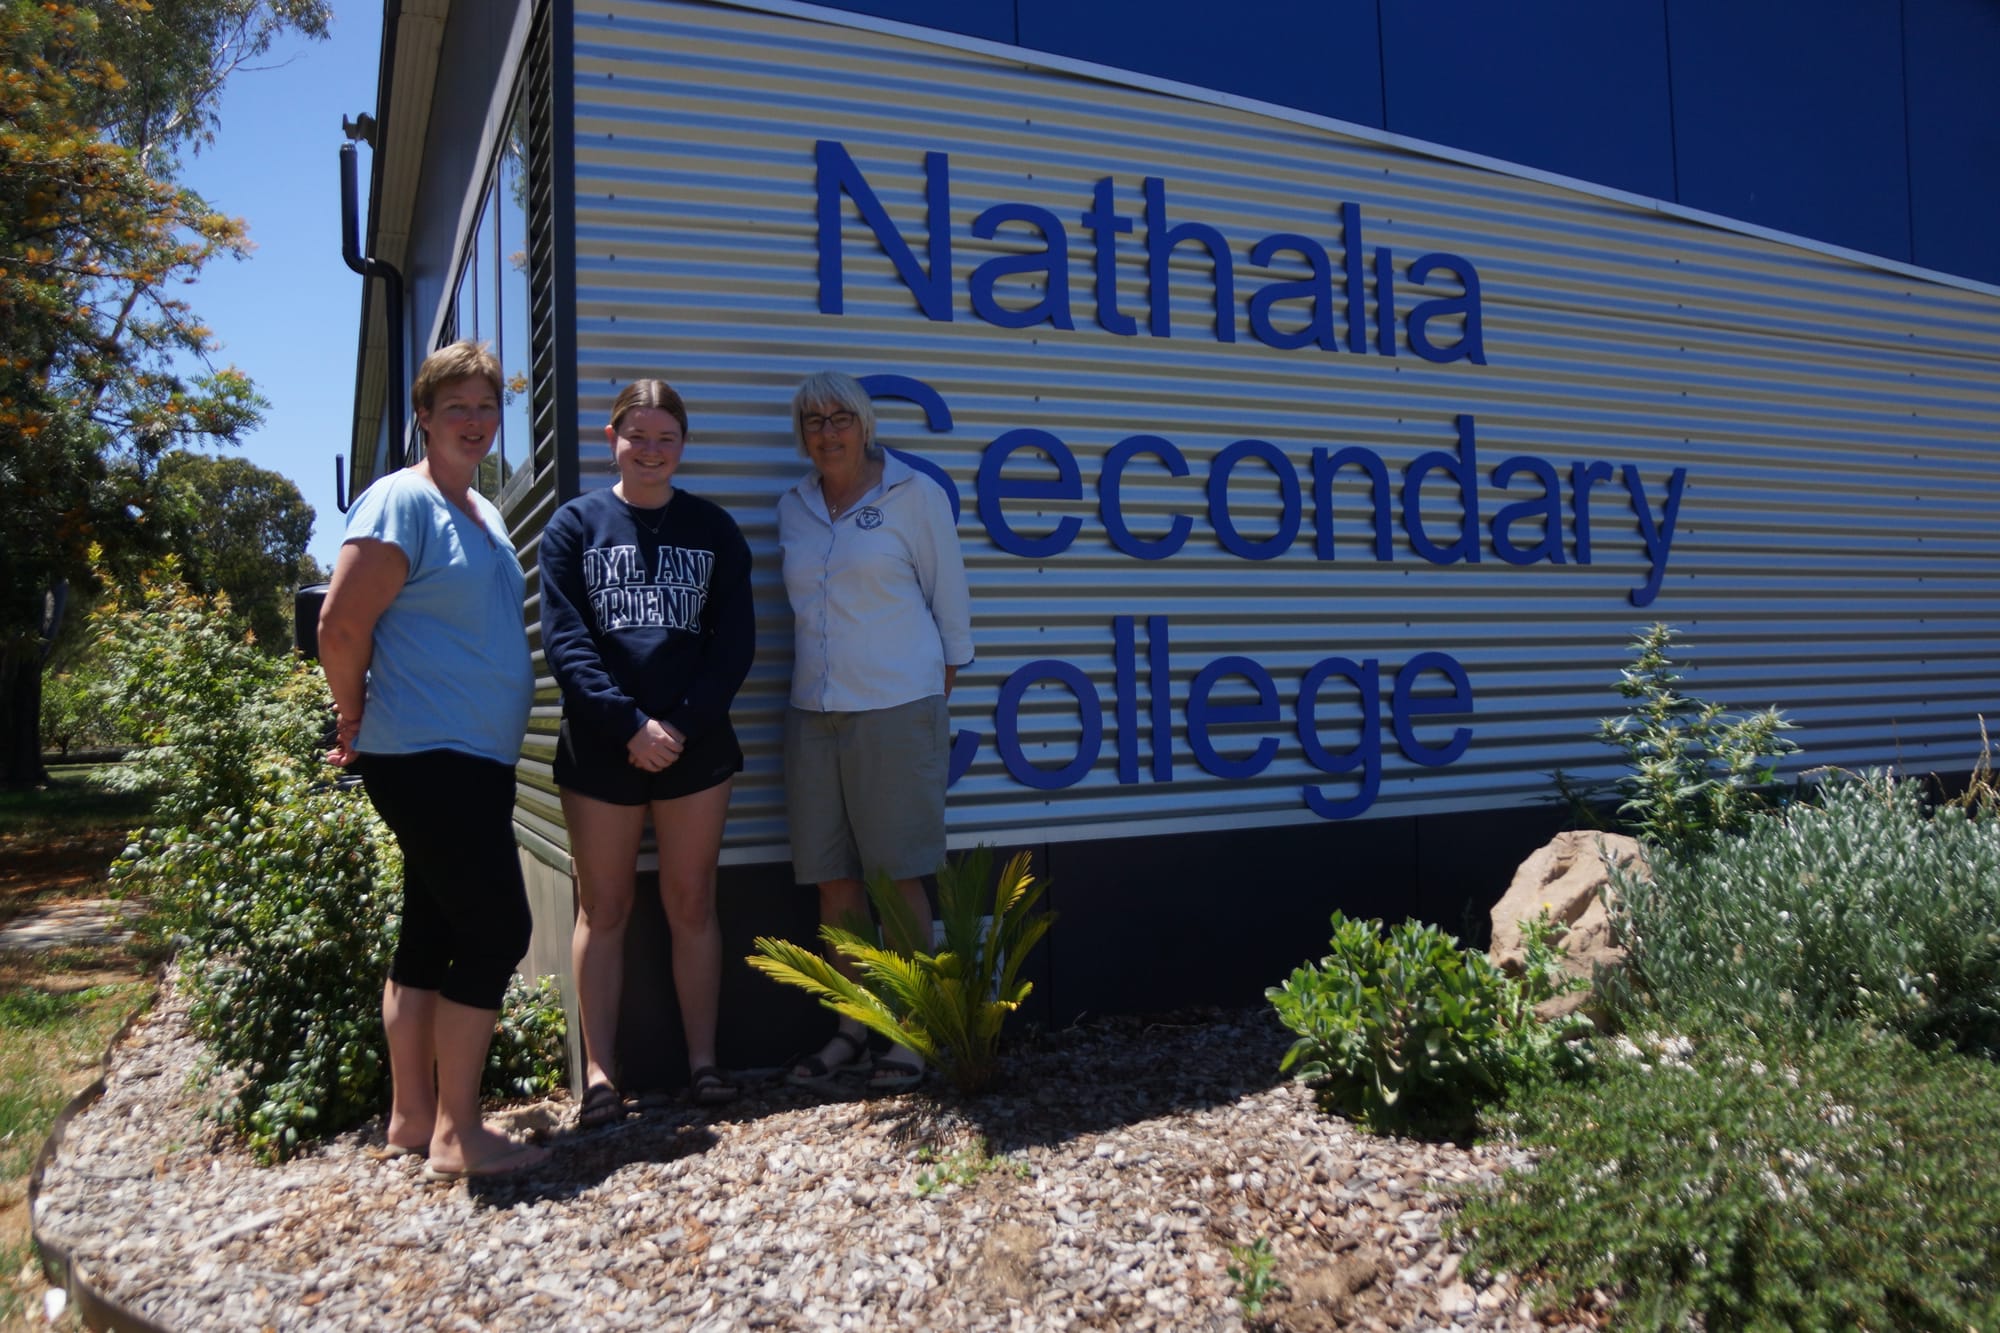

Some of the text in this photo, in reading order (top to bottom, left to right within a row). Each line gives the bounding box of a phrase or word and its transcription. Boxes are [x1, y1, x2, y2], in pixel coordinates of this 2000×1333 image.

[816, 139, 1486, 366] Nathalia
[588, 585, 708, 636] FRIEND
[946, 615, 1473, 820] ollege
